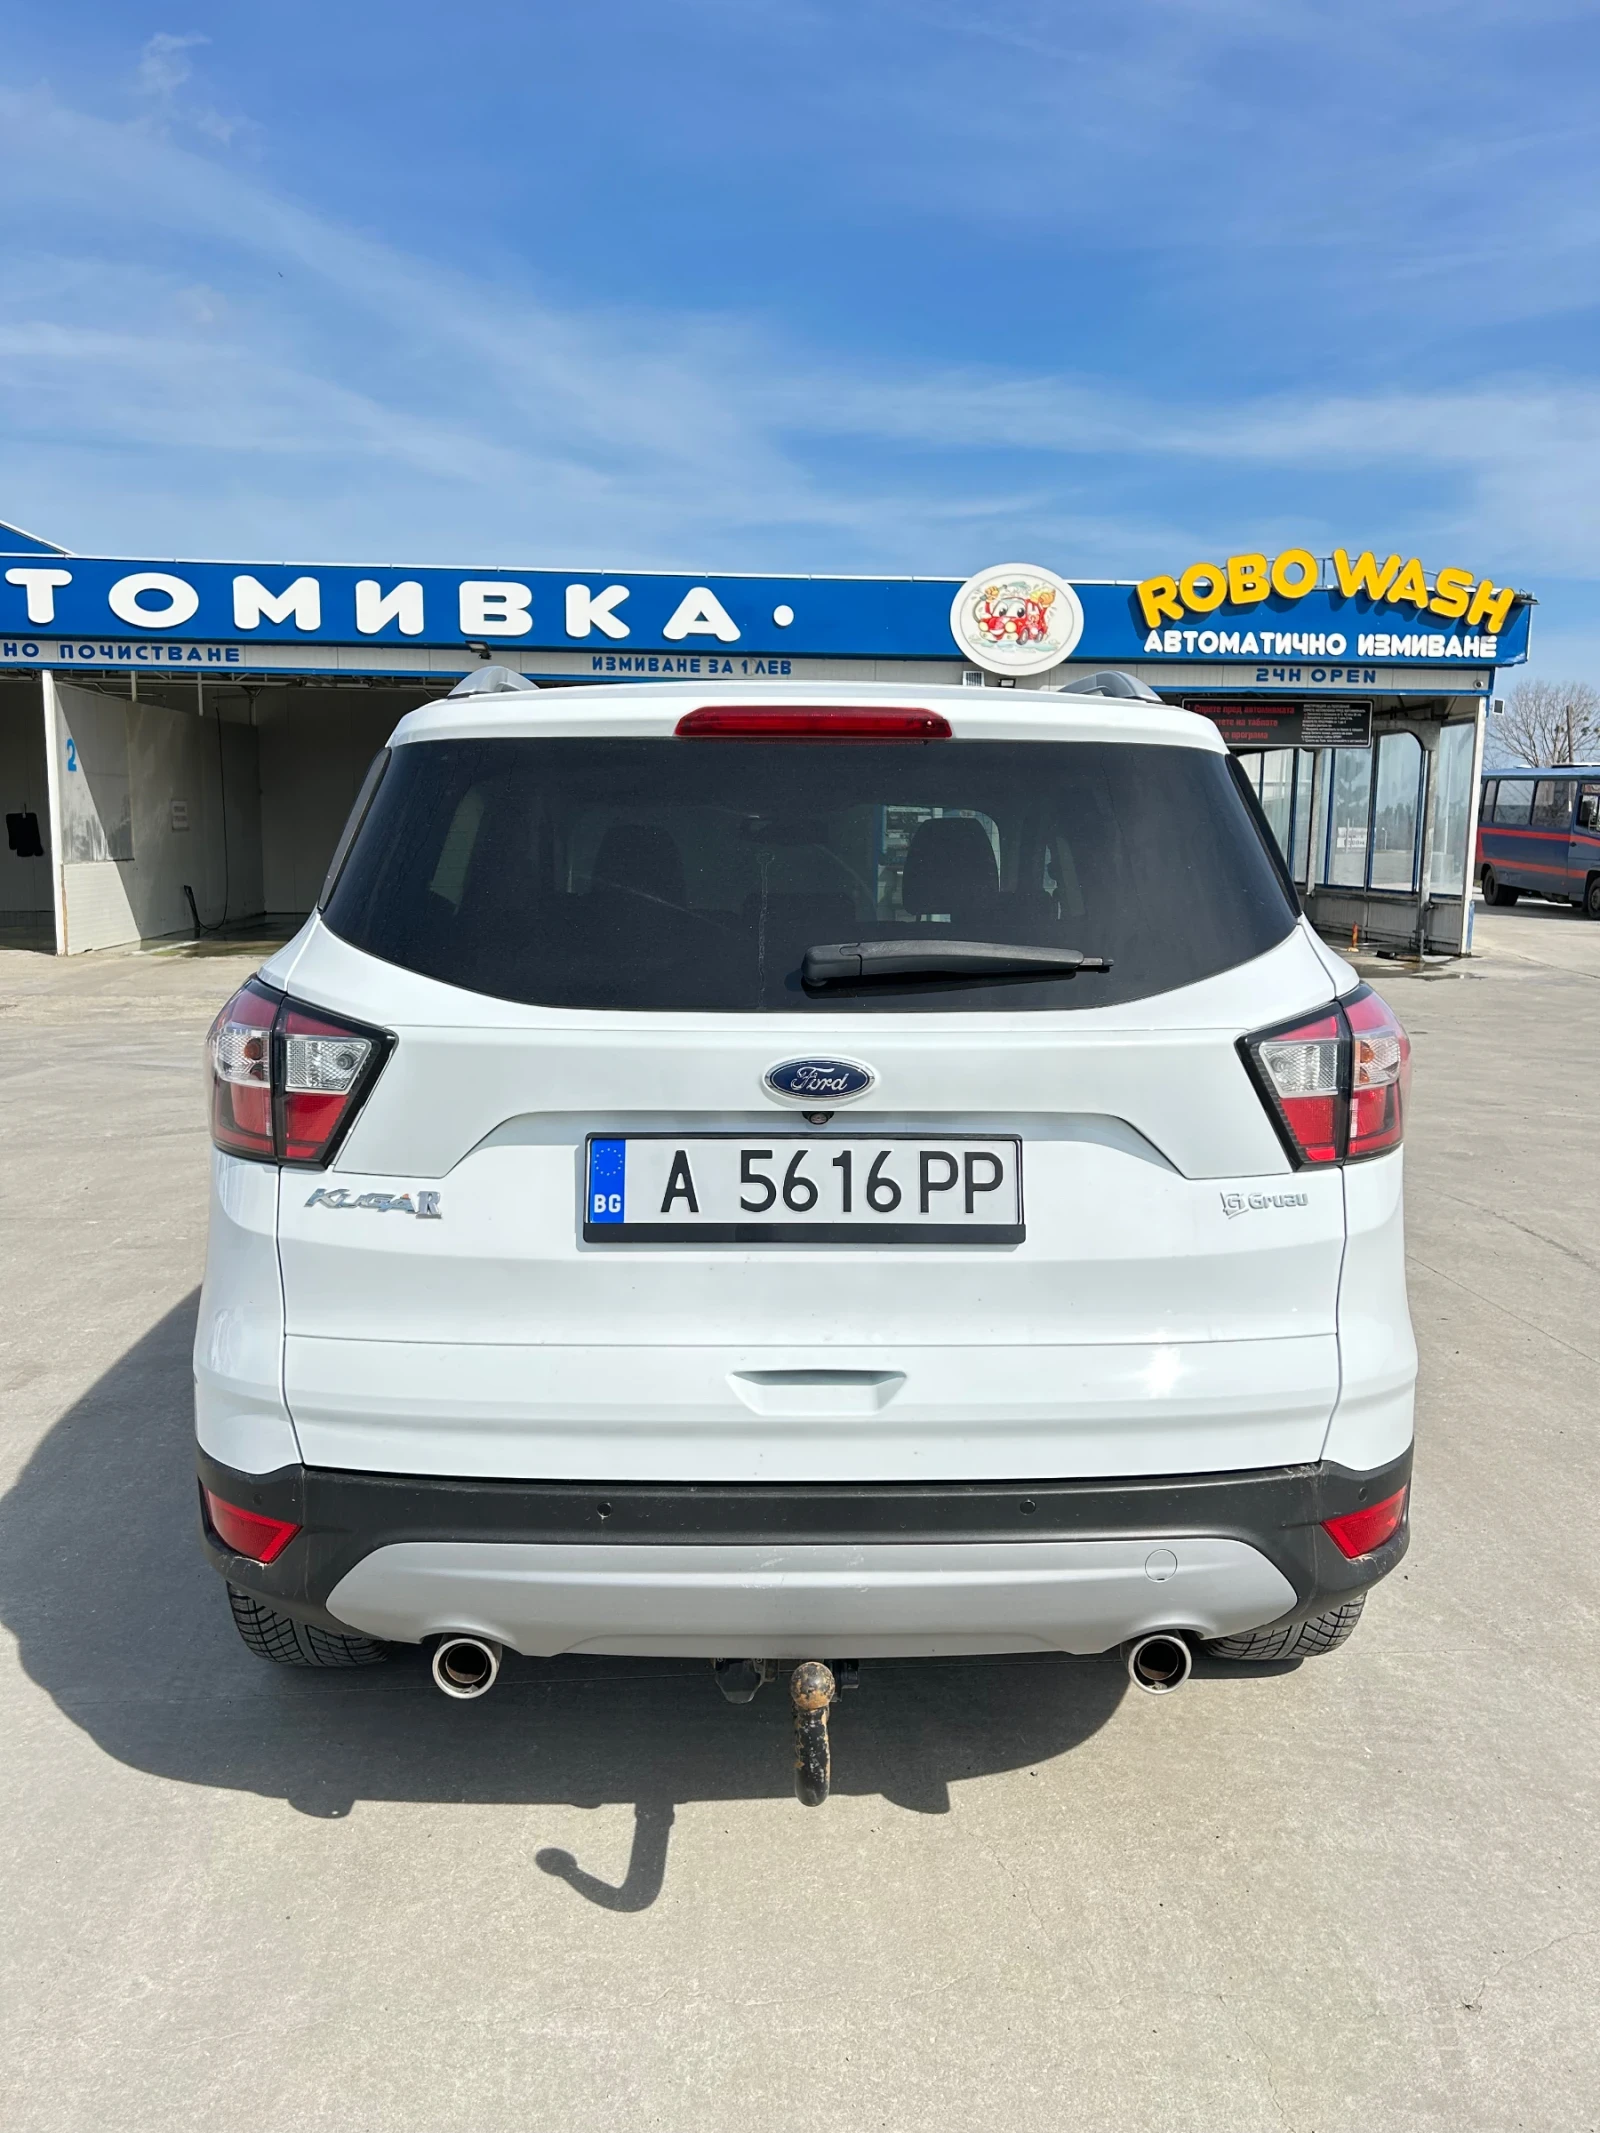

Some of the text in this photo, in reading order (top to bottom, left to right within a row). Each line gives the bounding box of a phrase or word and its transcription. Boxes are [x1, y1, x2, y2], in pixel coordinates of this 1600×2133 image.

[1136, 548, 1515, 634] ROBO WASH
[4, 567, 742, 643] ТОМИВКА
[59, 644, 240, 663] ПОЧИСТВАНЕ
[1143, 629, 1498, 659] АВТОМАТИЧНО ИЗМИВАНЕ
[592, 656, 792, 676] ИЗМИВАНЕ ЗА 1 ЛЕВ
[1255, 668, 1377, 684] 24H OPEN
[1231, 731, 1268, 740] програма
[67, 738, 77, 772] 2
[790, 1066, 850, 1091] Ford
[660, 1150, 700, 1213] A
[593, 1193, 622, 1213] BG
[1248, 1193, 1308, 1210] Gruau
